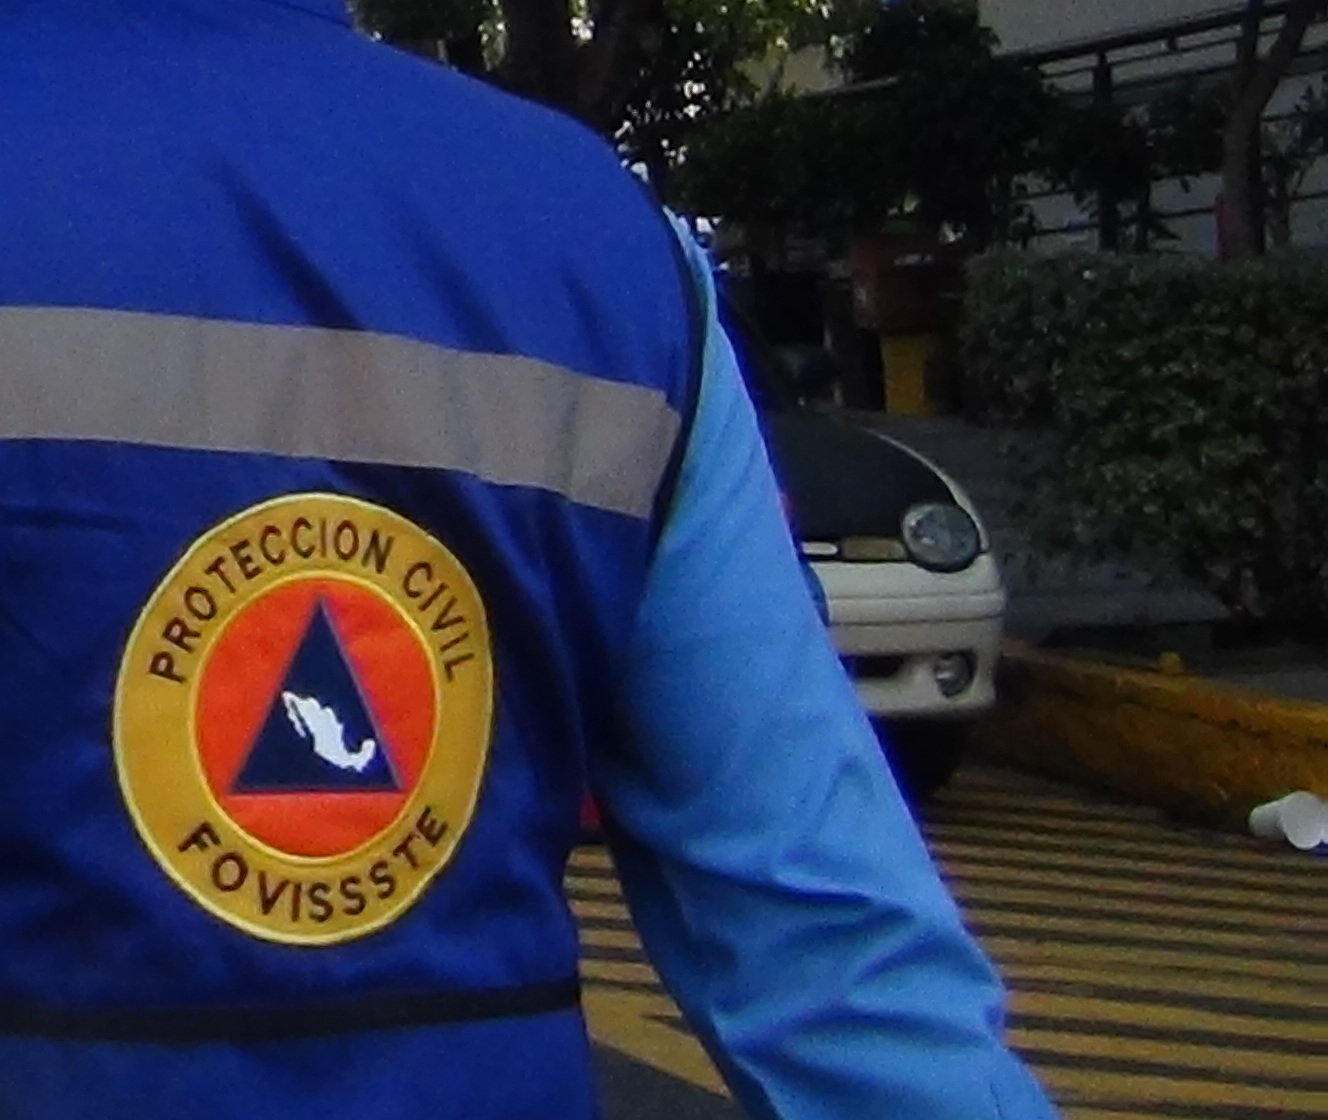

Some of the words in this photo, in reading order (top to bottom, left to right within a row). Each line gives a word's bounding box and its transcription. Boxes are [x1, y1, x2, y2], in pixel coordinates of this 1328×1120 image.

[148, 518, 394, 683] PROTECCION
[403, 562, 474, 681] CIVIL
[178, 806, 448, 922] FOVISSSTE
